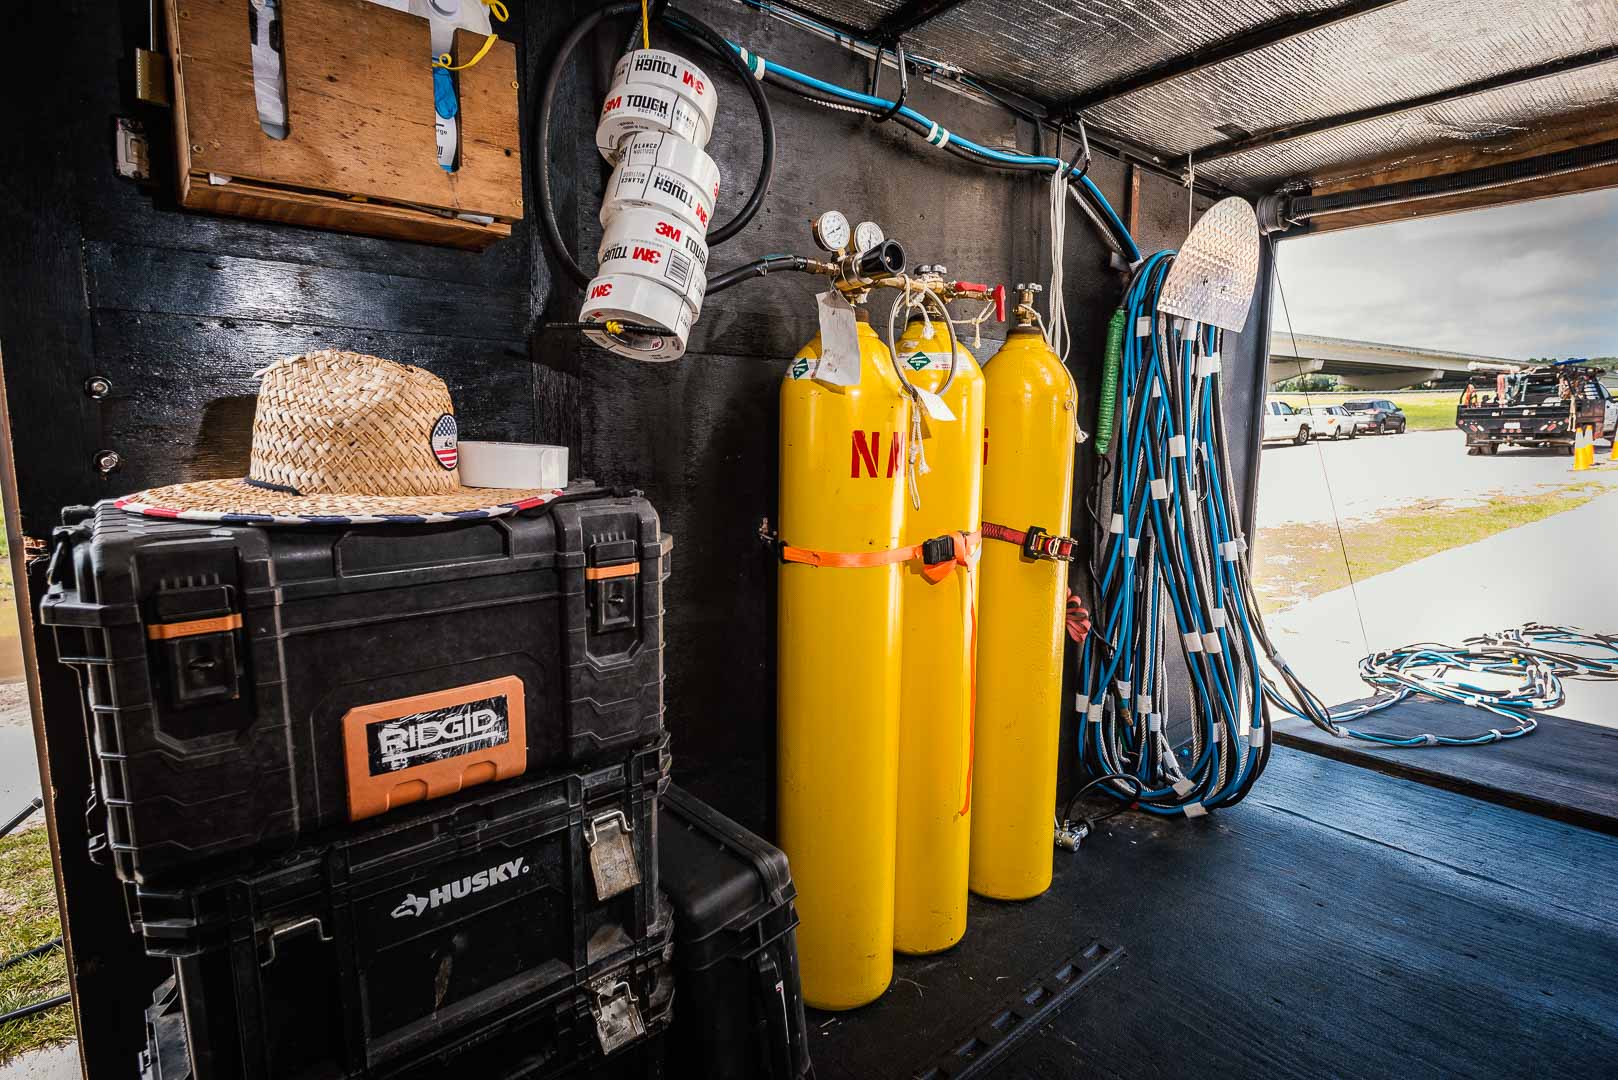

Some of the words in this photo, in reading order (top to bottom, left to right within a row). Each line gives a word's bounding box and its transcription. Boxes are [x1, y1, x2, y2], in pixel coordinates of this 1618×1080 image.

[635, 59, 678, 78] TOUGH
[682, 70, 705, 95] 3M
[603, 96, 622, 114] 3M
[627, 95, 668, 114] TOUGH
[653, 176, 693, 208] TOUGH
[655, 221, 682, 242] 3M
[632, 247, 661, 264] 3M
[591, 283, 612, 299] 3M
[378, 709, 498, 755] RIDGID
[429, 857, 524, 908] HUSKY
